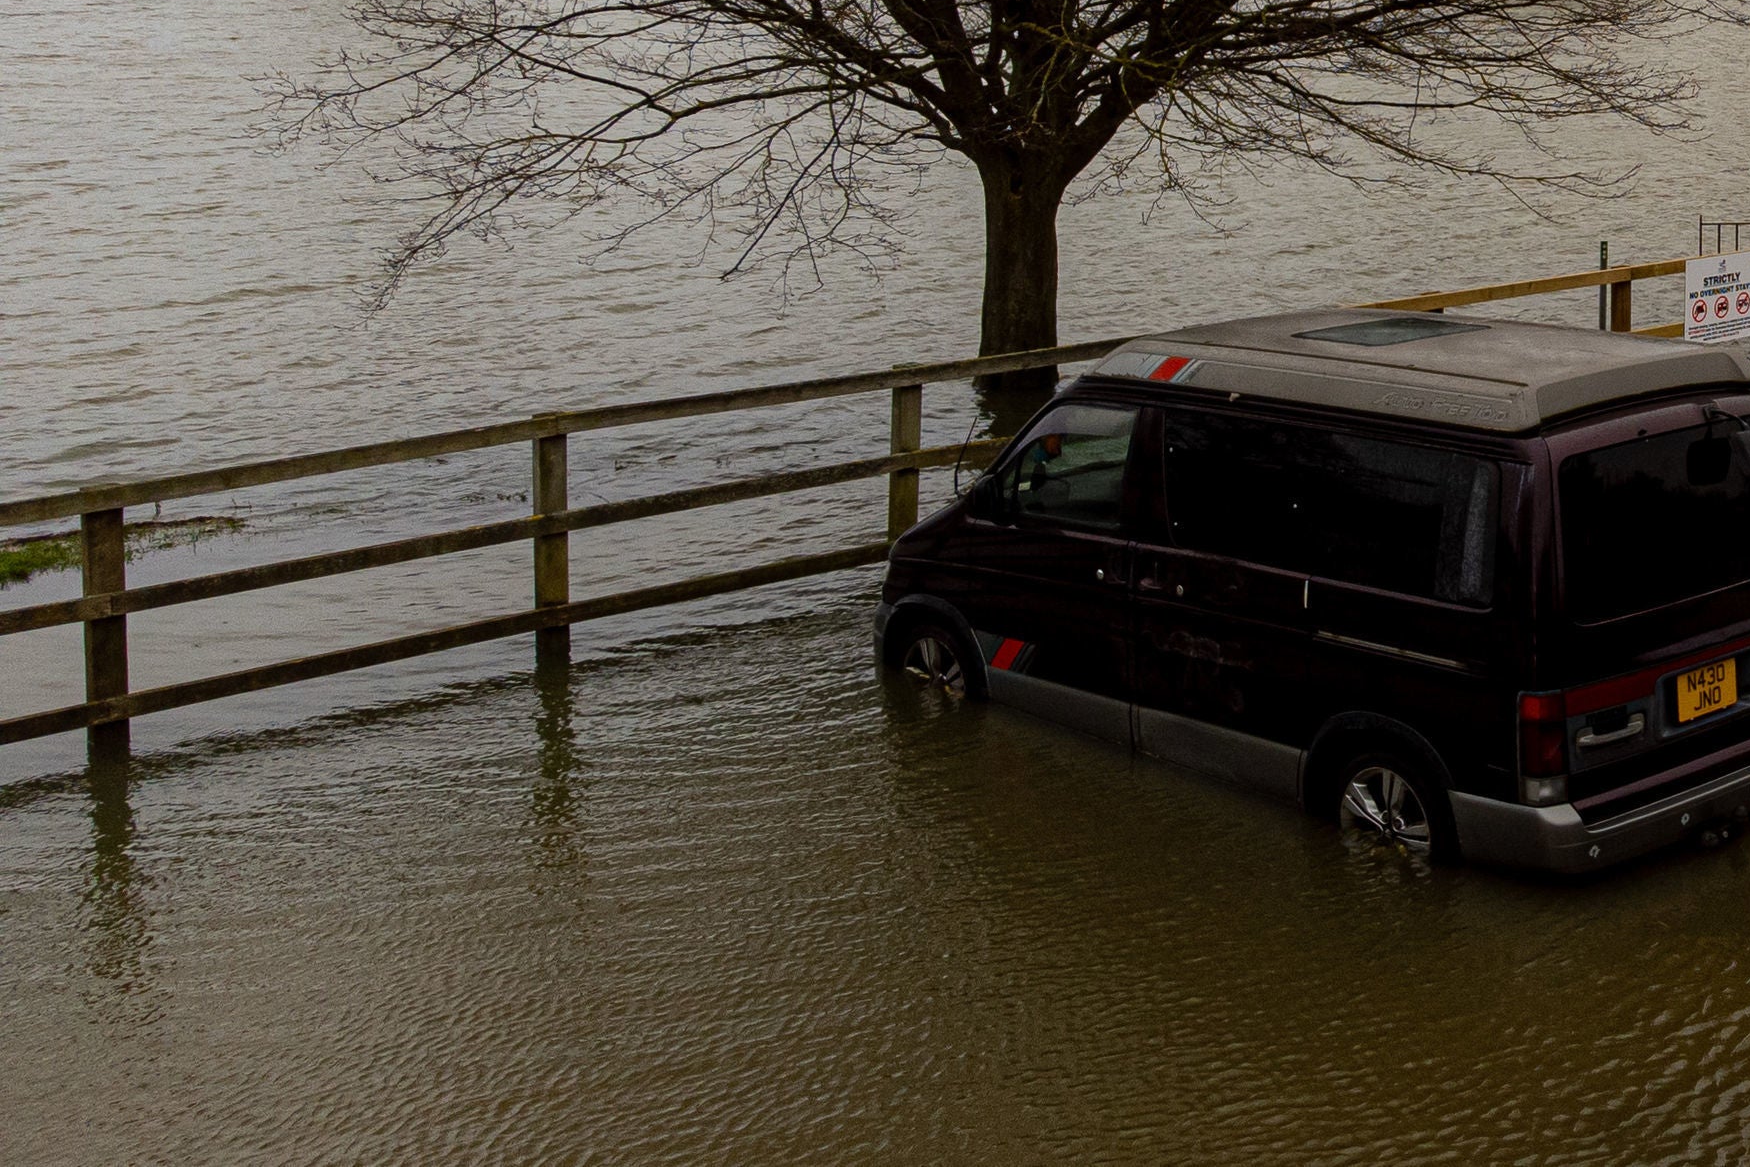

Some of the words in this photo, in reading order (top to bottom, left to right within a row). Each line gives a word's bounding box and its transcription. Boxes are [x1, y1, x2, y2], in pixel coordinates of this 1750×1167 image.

[1703, 272, 1741, 286] STRICTLY
[1689, 291, 1699, 299] NO
[1700, 285, 1734, 297] OVERNIGHT
[1687, 663, 1725, 693] N430
[1694, 686, 1722, 711] JNO
